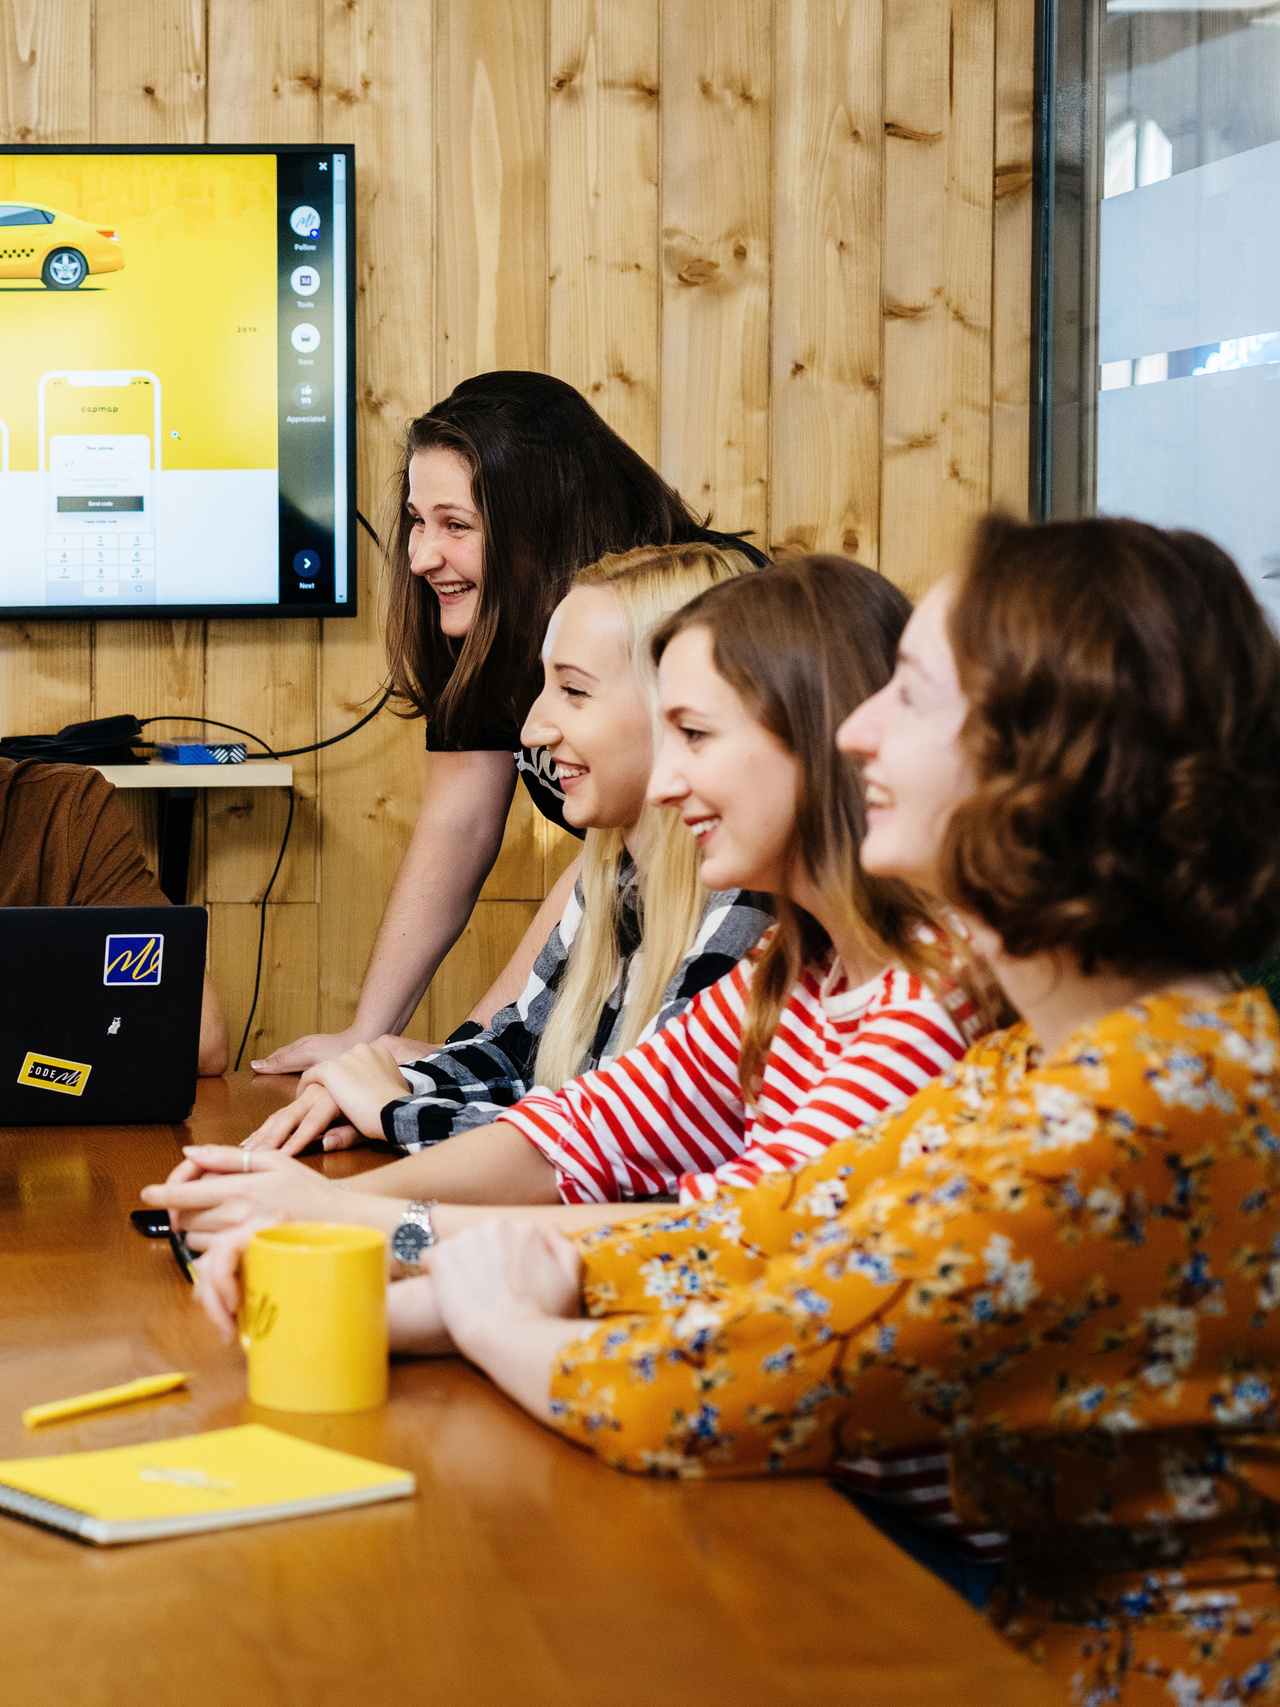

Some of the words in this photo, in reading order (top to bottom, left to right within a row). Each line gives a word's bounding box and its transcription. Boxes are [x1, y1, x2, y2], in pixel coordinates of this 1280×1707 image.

[293, 243, 317, 251] Follow
[297, 300, 315, 309] Tools
[297, 358, 315, 366] Save
[286, 415, 327, 424] Appreciated
[28, 1065, 56, 1079] CODE
